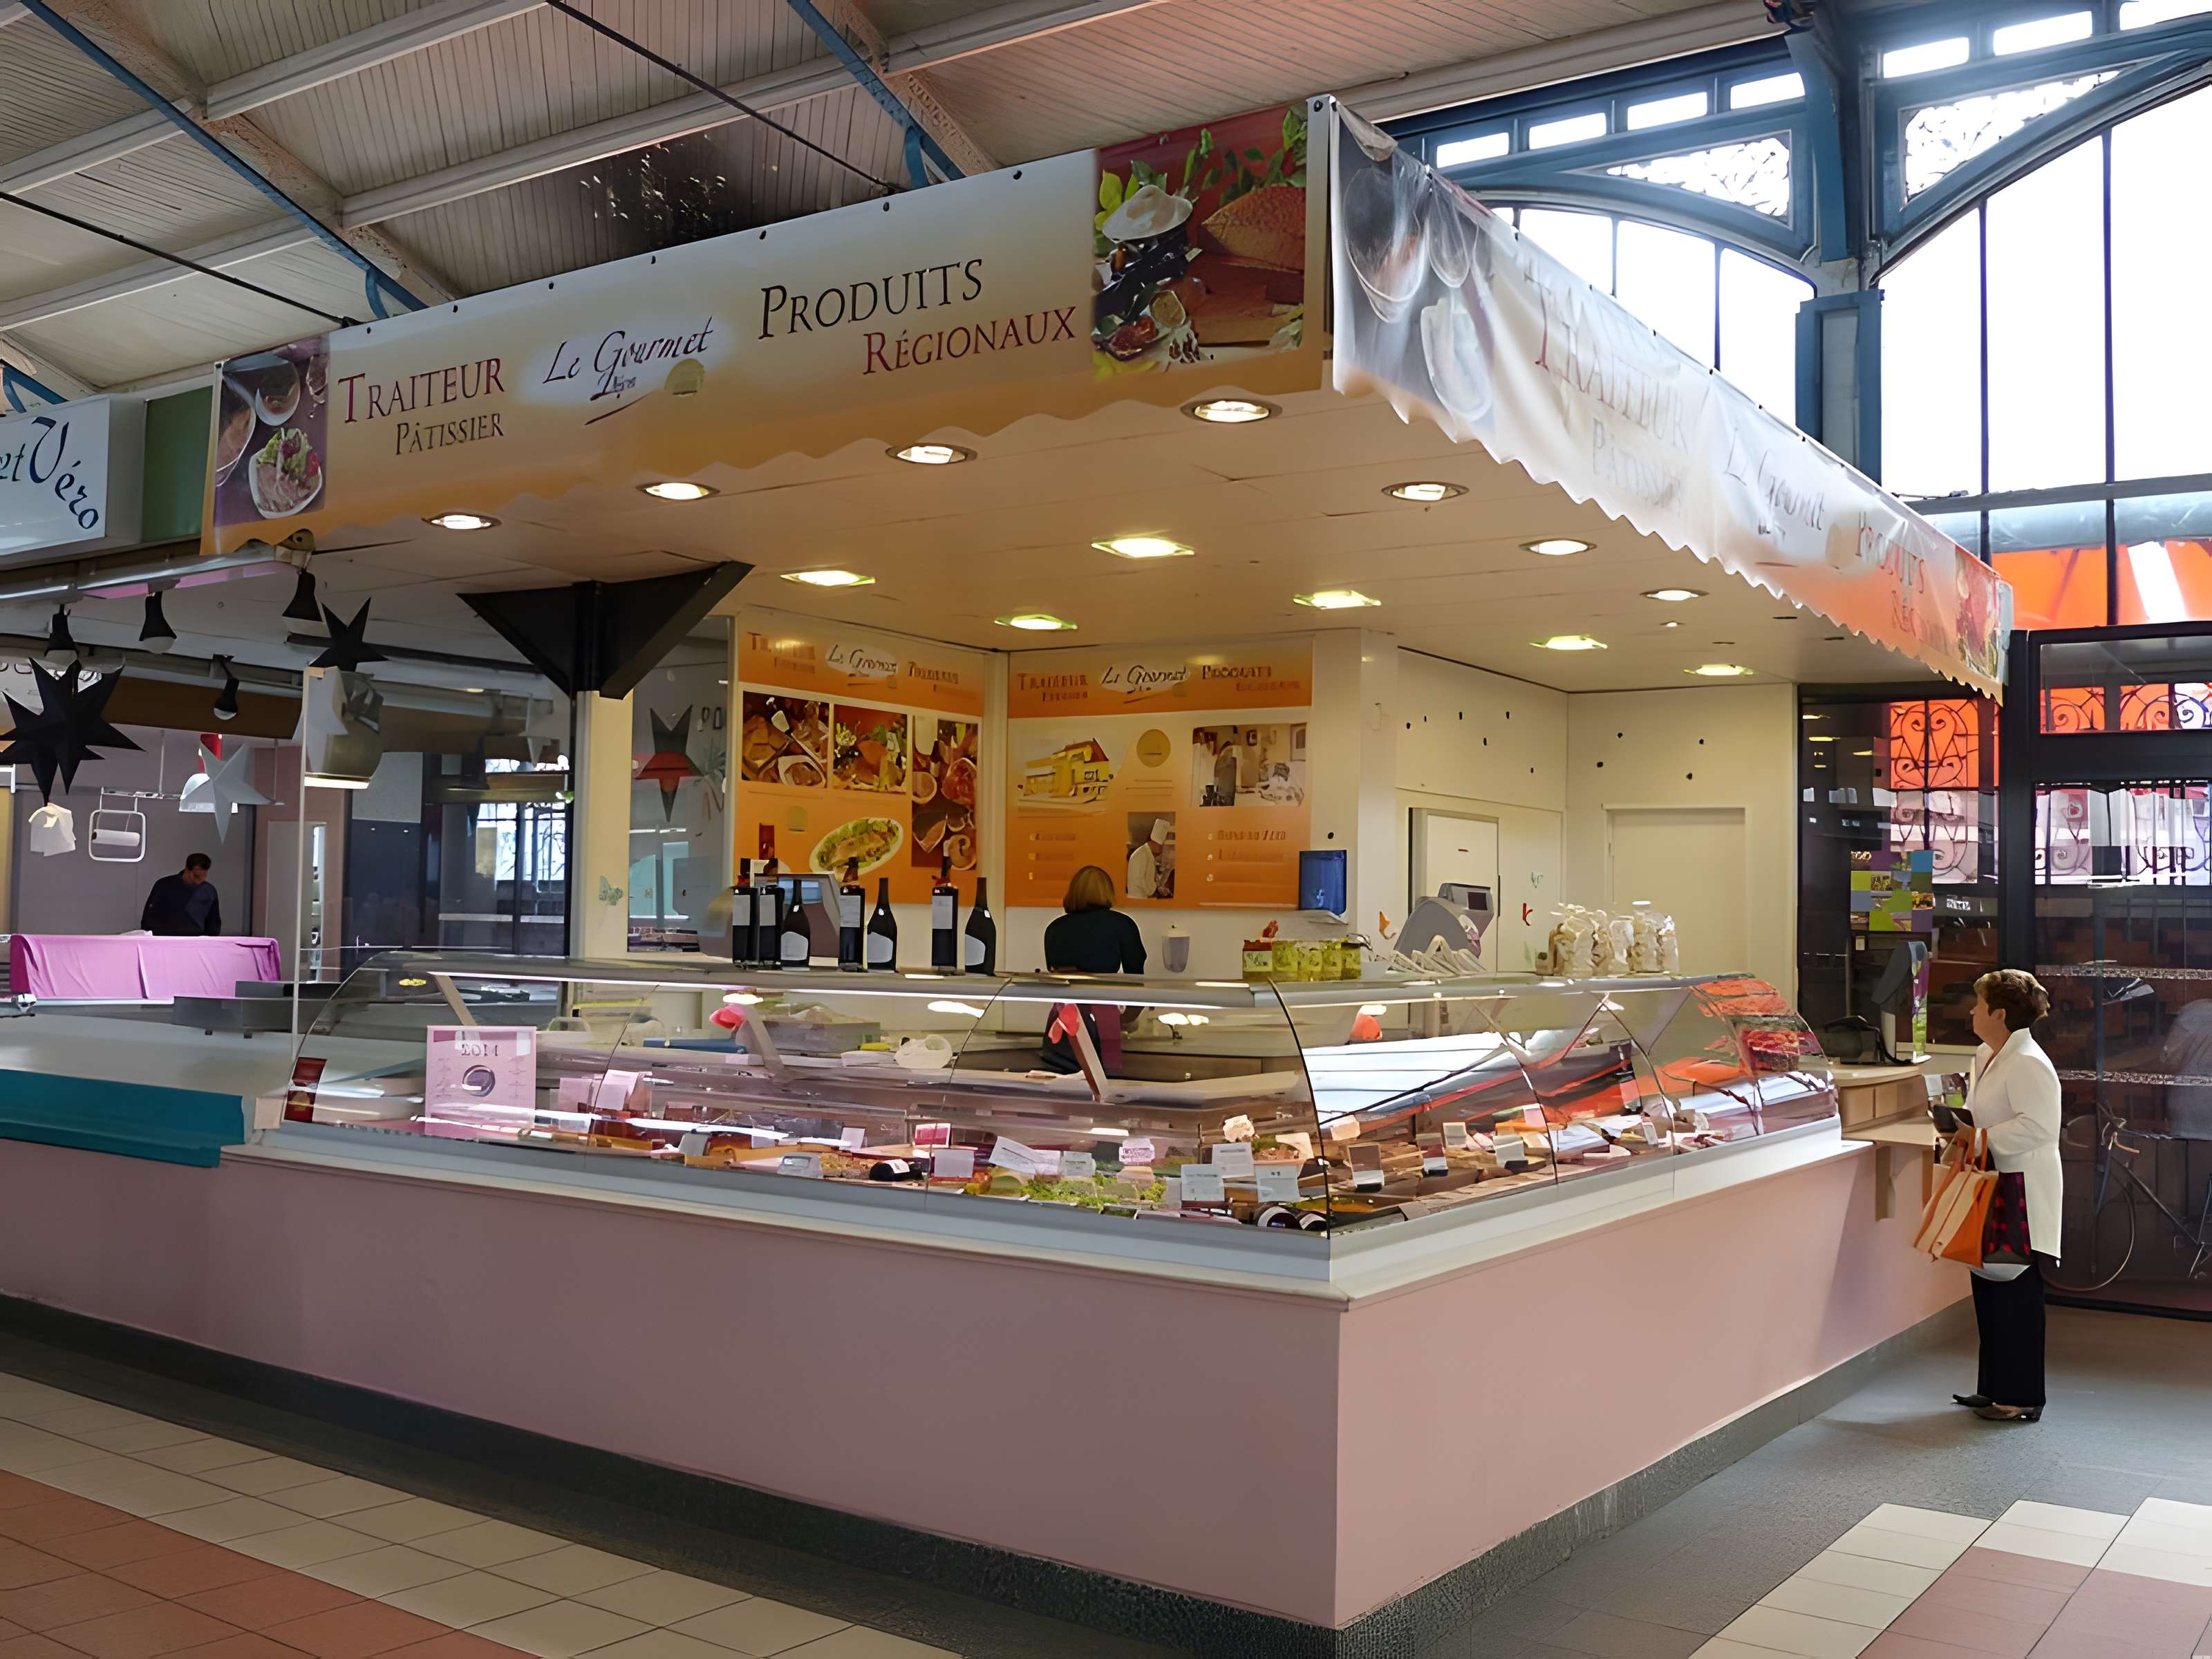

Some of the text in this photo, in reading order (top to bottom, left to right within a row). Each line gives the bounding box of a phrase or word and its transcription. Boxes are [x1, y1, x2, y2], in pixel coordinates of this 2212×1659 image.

[758, 259, 982, 339] PRODUITS
[863, 306, 1076, 375] RÉGIONAUX
[337, 358, 505, 424] TRAITEUR
[30, 416, 99, 529] Véro
